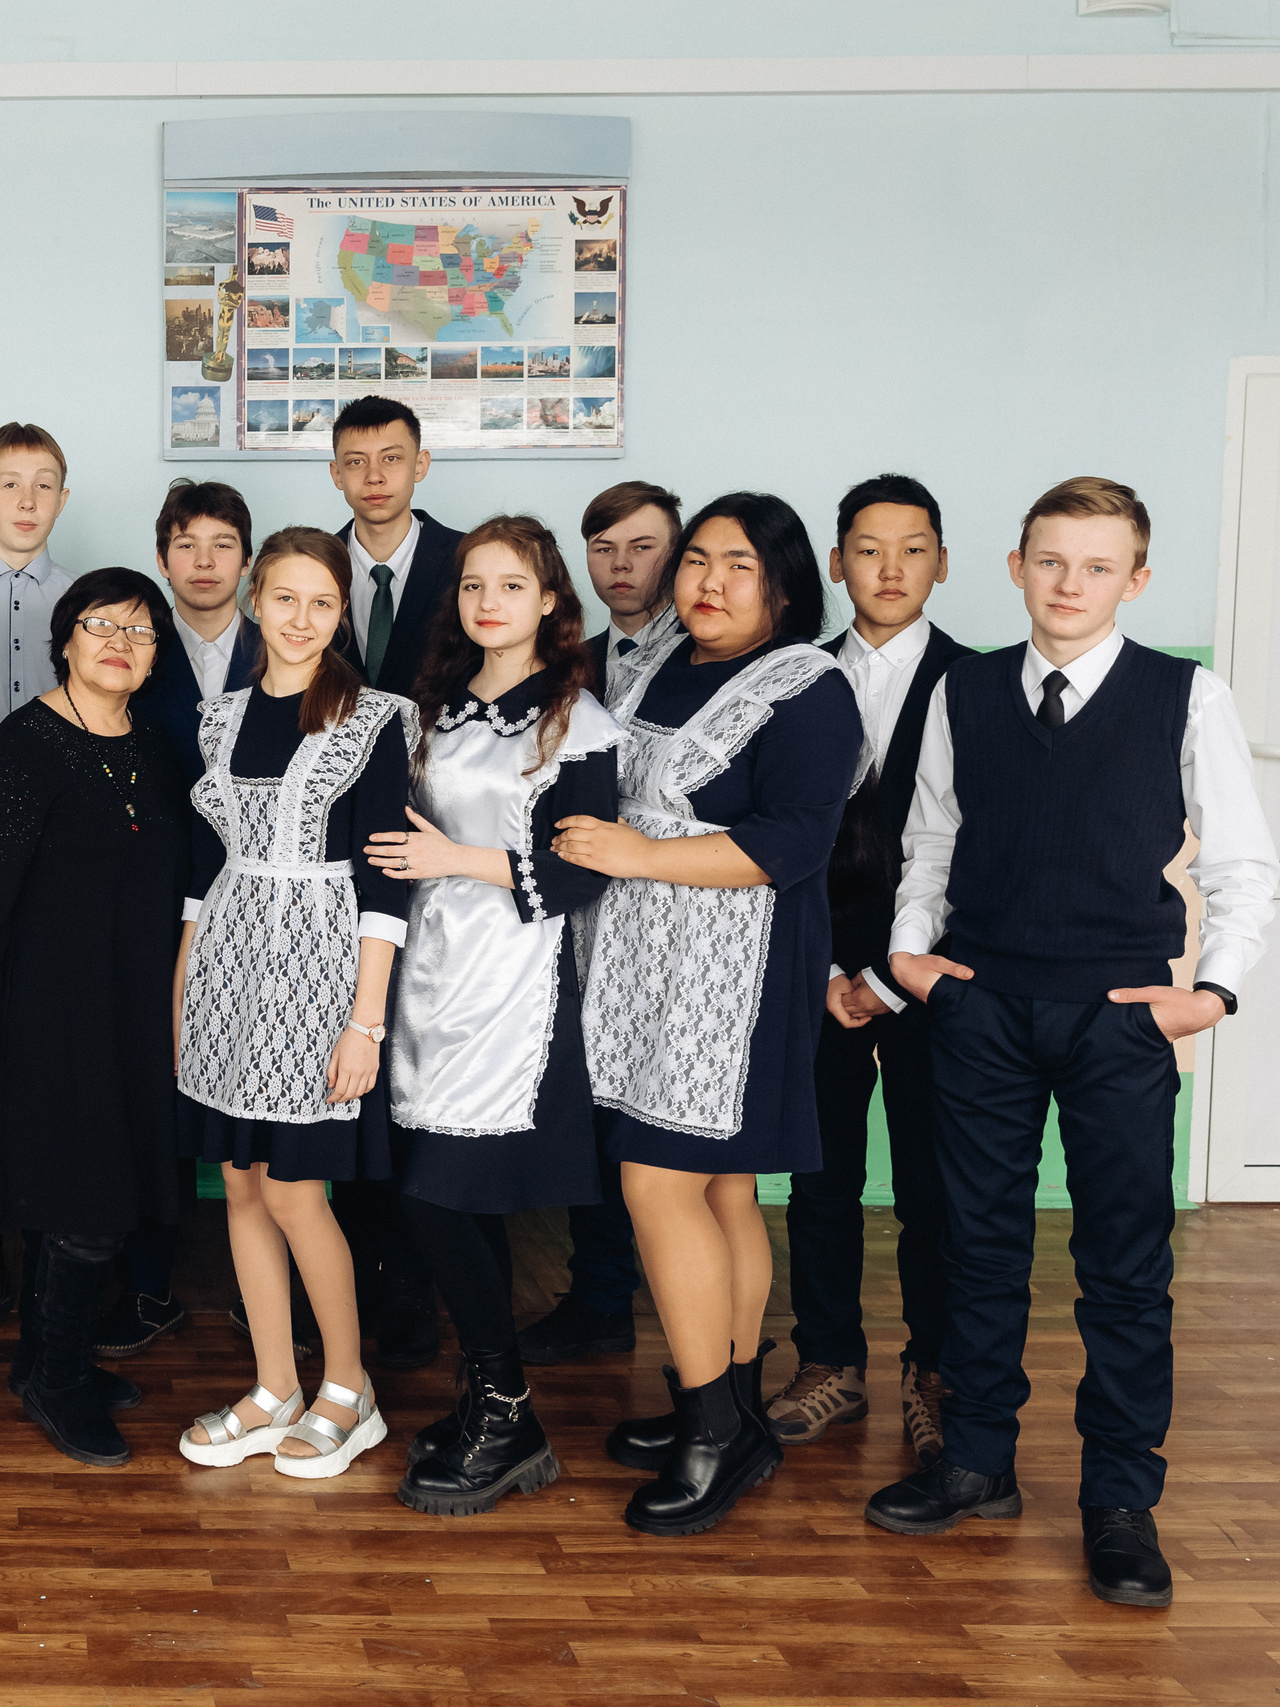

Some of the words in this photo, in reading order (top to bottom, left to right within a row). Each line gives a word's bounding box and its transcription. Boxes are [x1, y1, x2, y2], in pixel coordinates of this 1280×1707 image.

[307, 198, 331, 208] The
[338, 197, 395, 208] UNITED
[400, 196, 457, 208] STATES
[462, 196, 482, 207] OF
[488, 195, 556, 206] AMERICA
